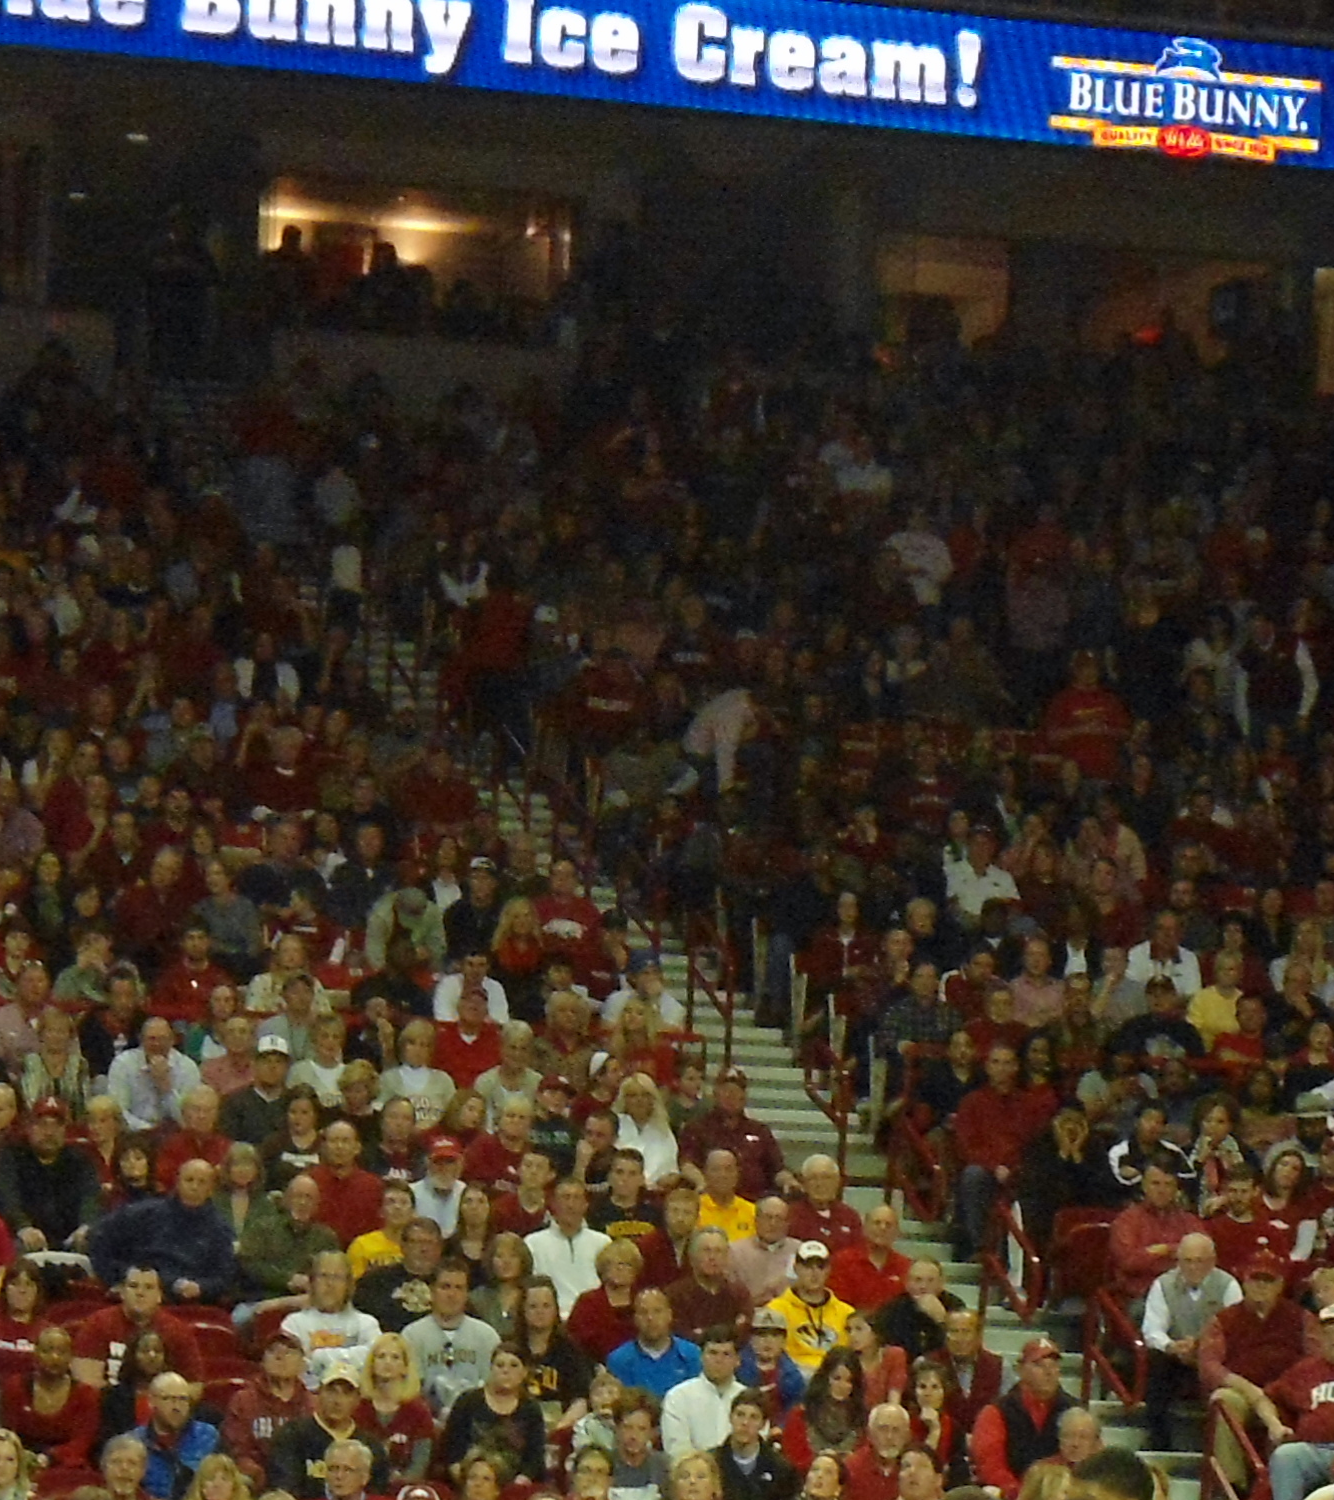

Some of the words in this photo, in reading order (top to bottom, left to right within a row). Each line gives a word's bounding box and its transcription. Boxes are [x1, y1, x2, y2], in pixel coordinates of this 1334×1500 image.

[501, 0, 640, 75] Ice
[673, 3, 981, 108] Cream!
[1069, 72, 1164, 119] BLUE
